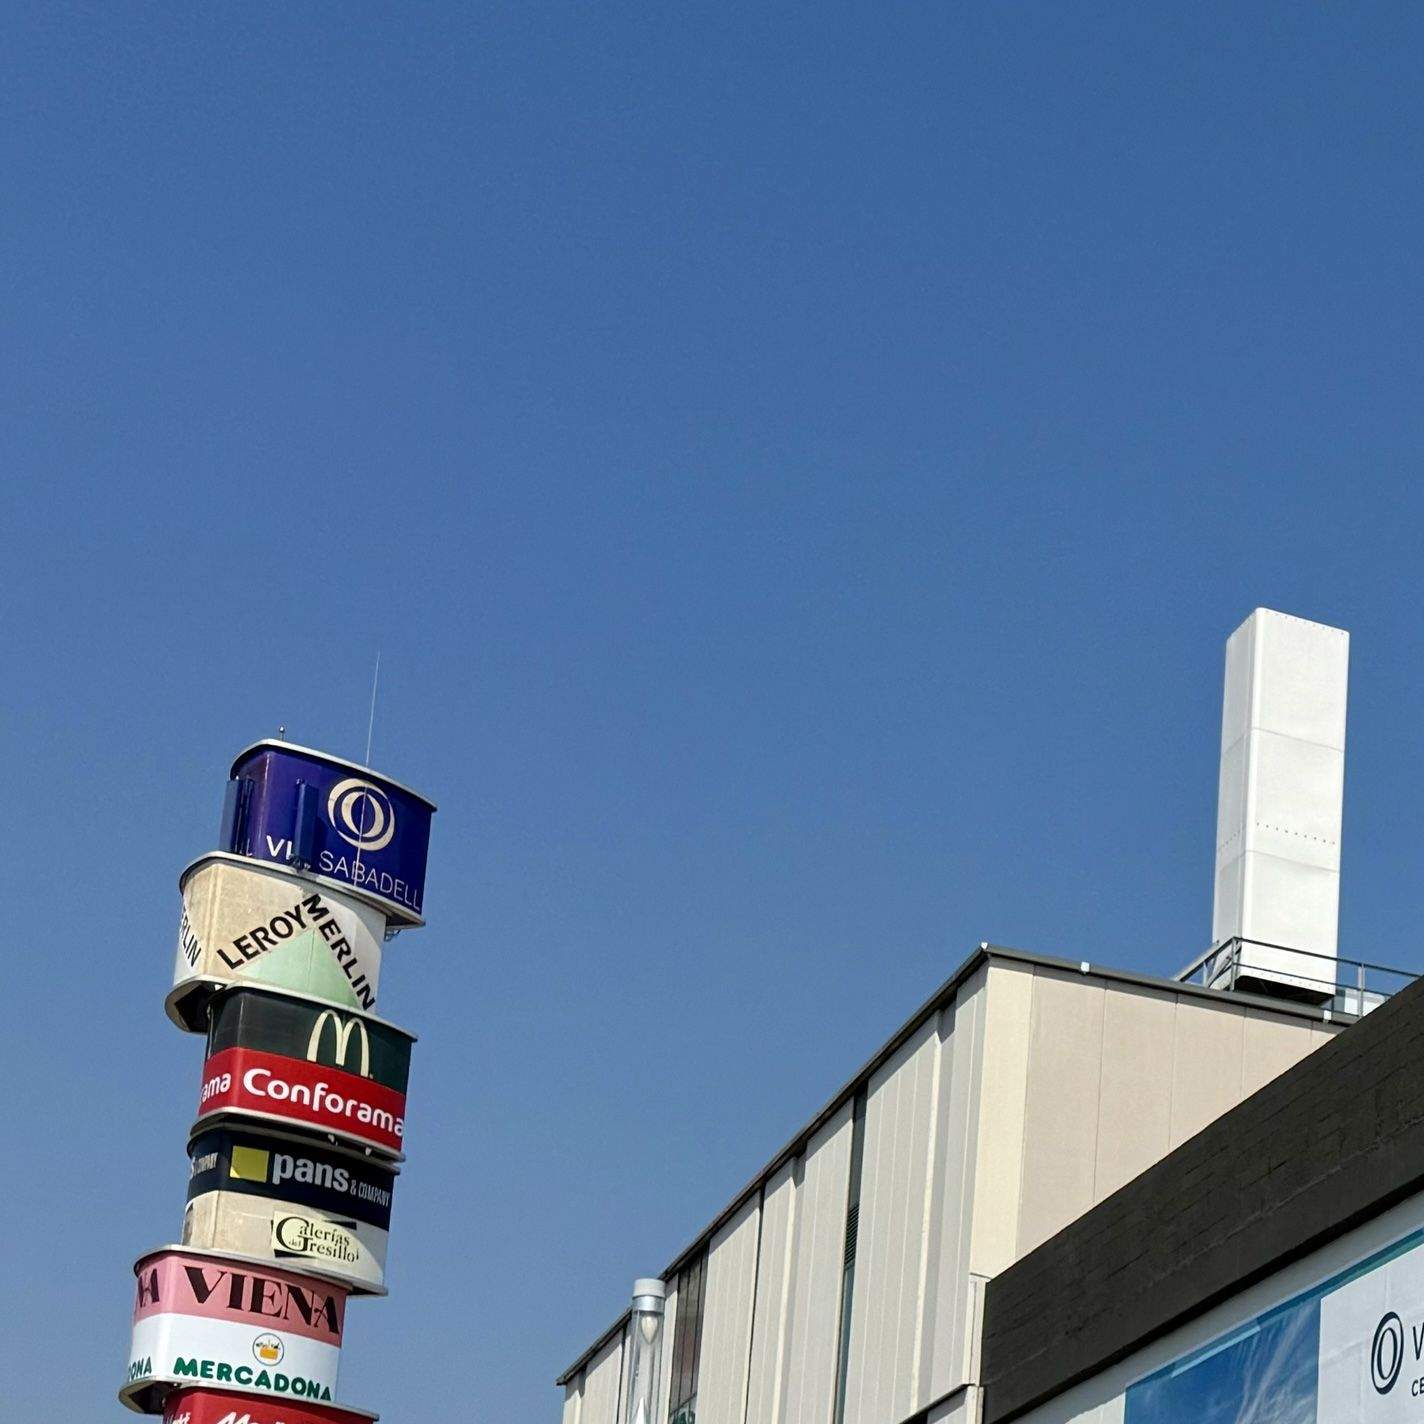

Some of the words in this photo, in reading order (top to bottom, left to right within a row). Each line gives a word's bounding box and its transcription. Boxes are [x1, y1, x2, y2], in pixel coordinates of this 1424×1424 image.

[319, 850, 421, 911] SABADELL
[216, 905, 306, 970] LEROY
[302, 894, 376, 1010] MERLIN
[243, 1068, 404, 1136] Conforama
[272, 1153, 349, 1192] pans
[358, 1182, 391, 1208] COMPANY
[184, 1266, 340, 1334] VIENA
[173, 1357, 333, 1401] MERCADONA
